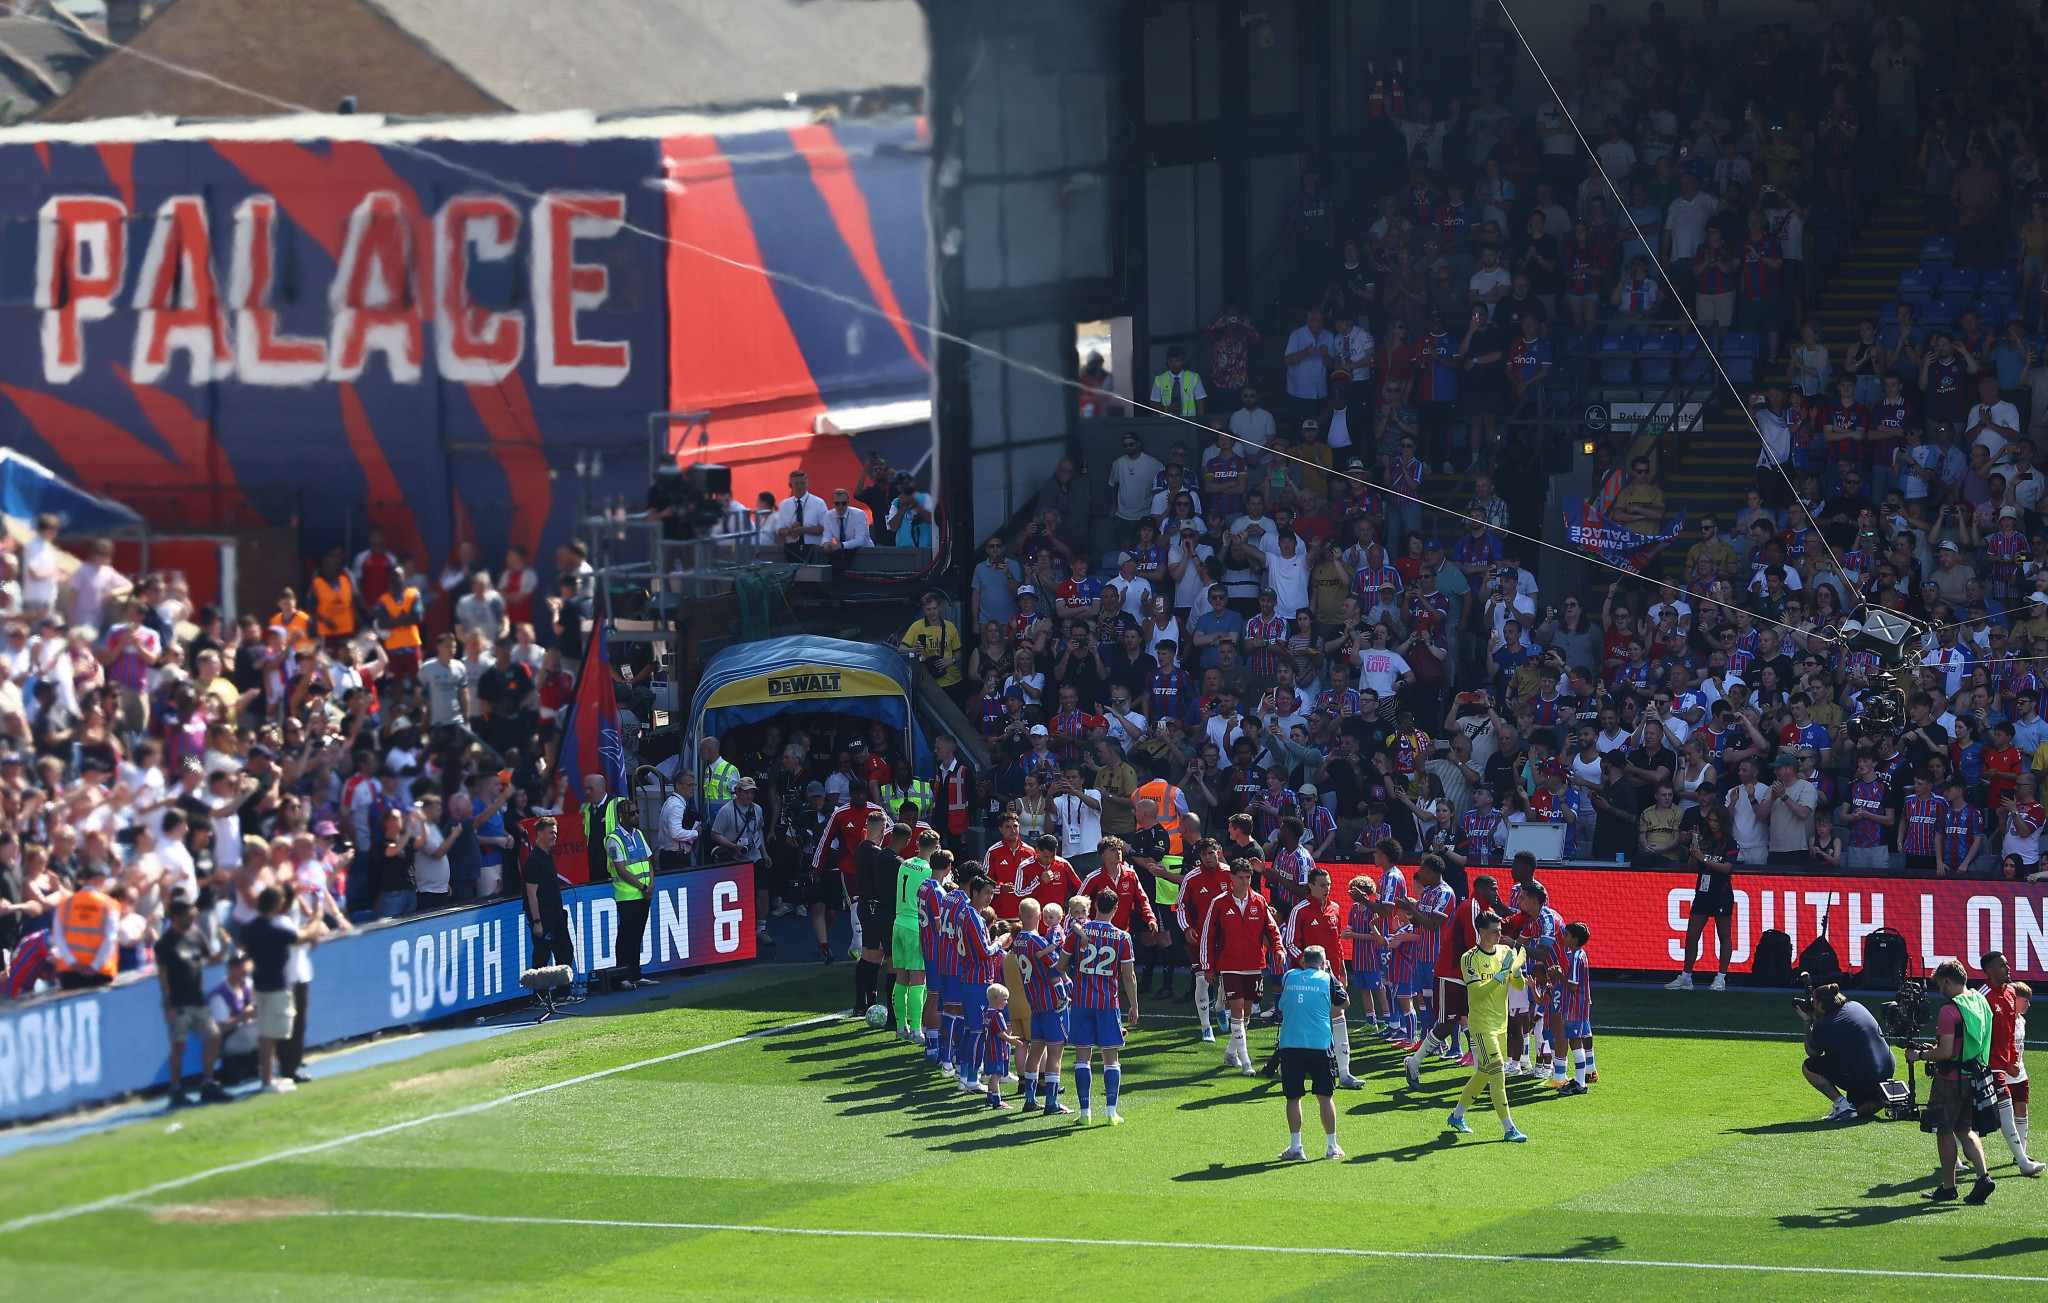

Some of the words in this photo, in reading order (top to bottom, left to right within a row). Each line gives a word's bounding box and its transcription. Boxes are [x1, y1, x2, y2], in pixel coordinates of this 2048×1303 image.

[34, 191, 631, 387] PALACE
[1422, 345, 1447, 356] cich
[1513, 354, 1536, 365] cinch
[1619, 412, 1695, 423] Refrehmnts
[1571, 526, 1631, 542] PALACE
[1571, 536, 1623, 550] FAMOUS
[1067, 595, 1091, 606] cinch
[929, 637, 948, 650] Tulp
[1366, 660, 1390, 674] LOVE
[1464, 721, 1491, 736] RESST
[1910, 815, 1937, 824] NET88
[903, 874, 911, 903] 1
[1667, 888, 1885, 967] SOUTH
[1101, 930, 1121, 941] LARSEN
[390, 919, 503, 1019] SOUTH
[519, 887, 691, 988] LNDN
[712, 881, 743, 954] &
[1080, 943, 1116, 976] 22
[1297, 993, 1305, 1003] 6
